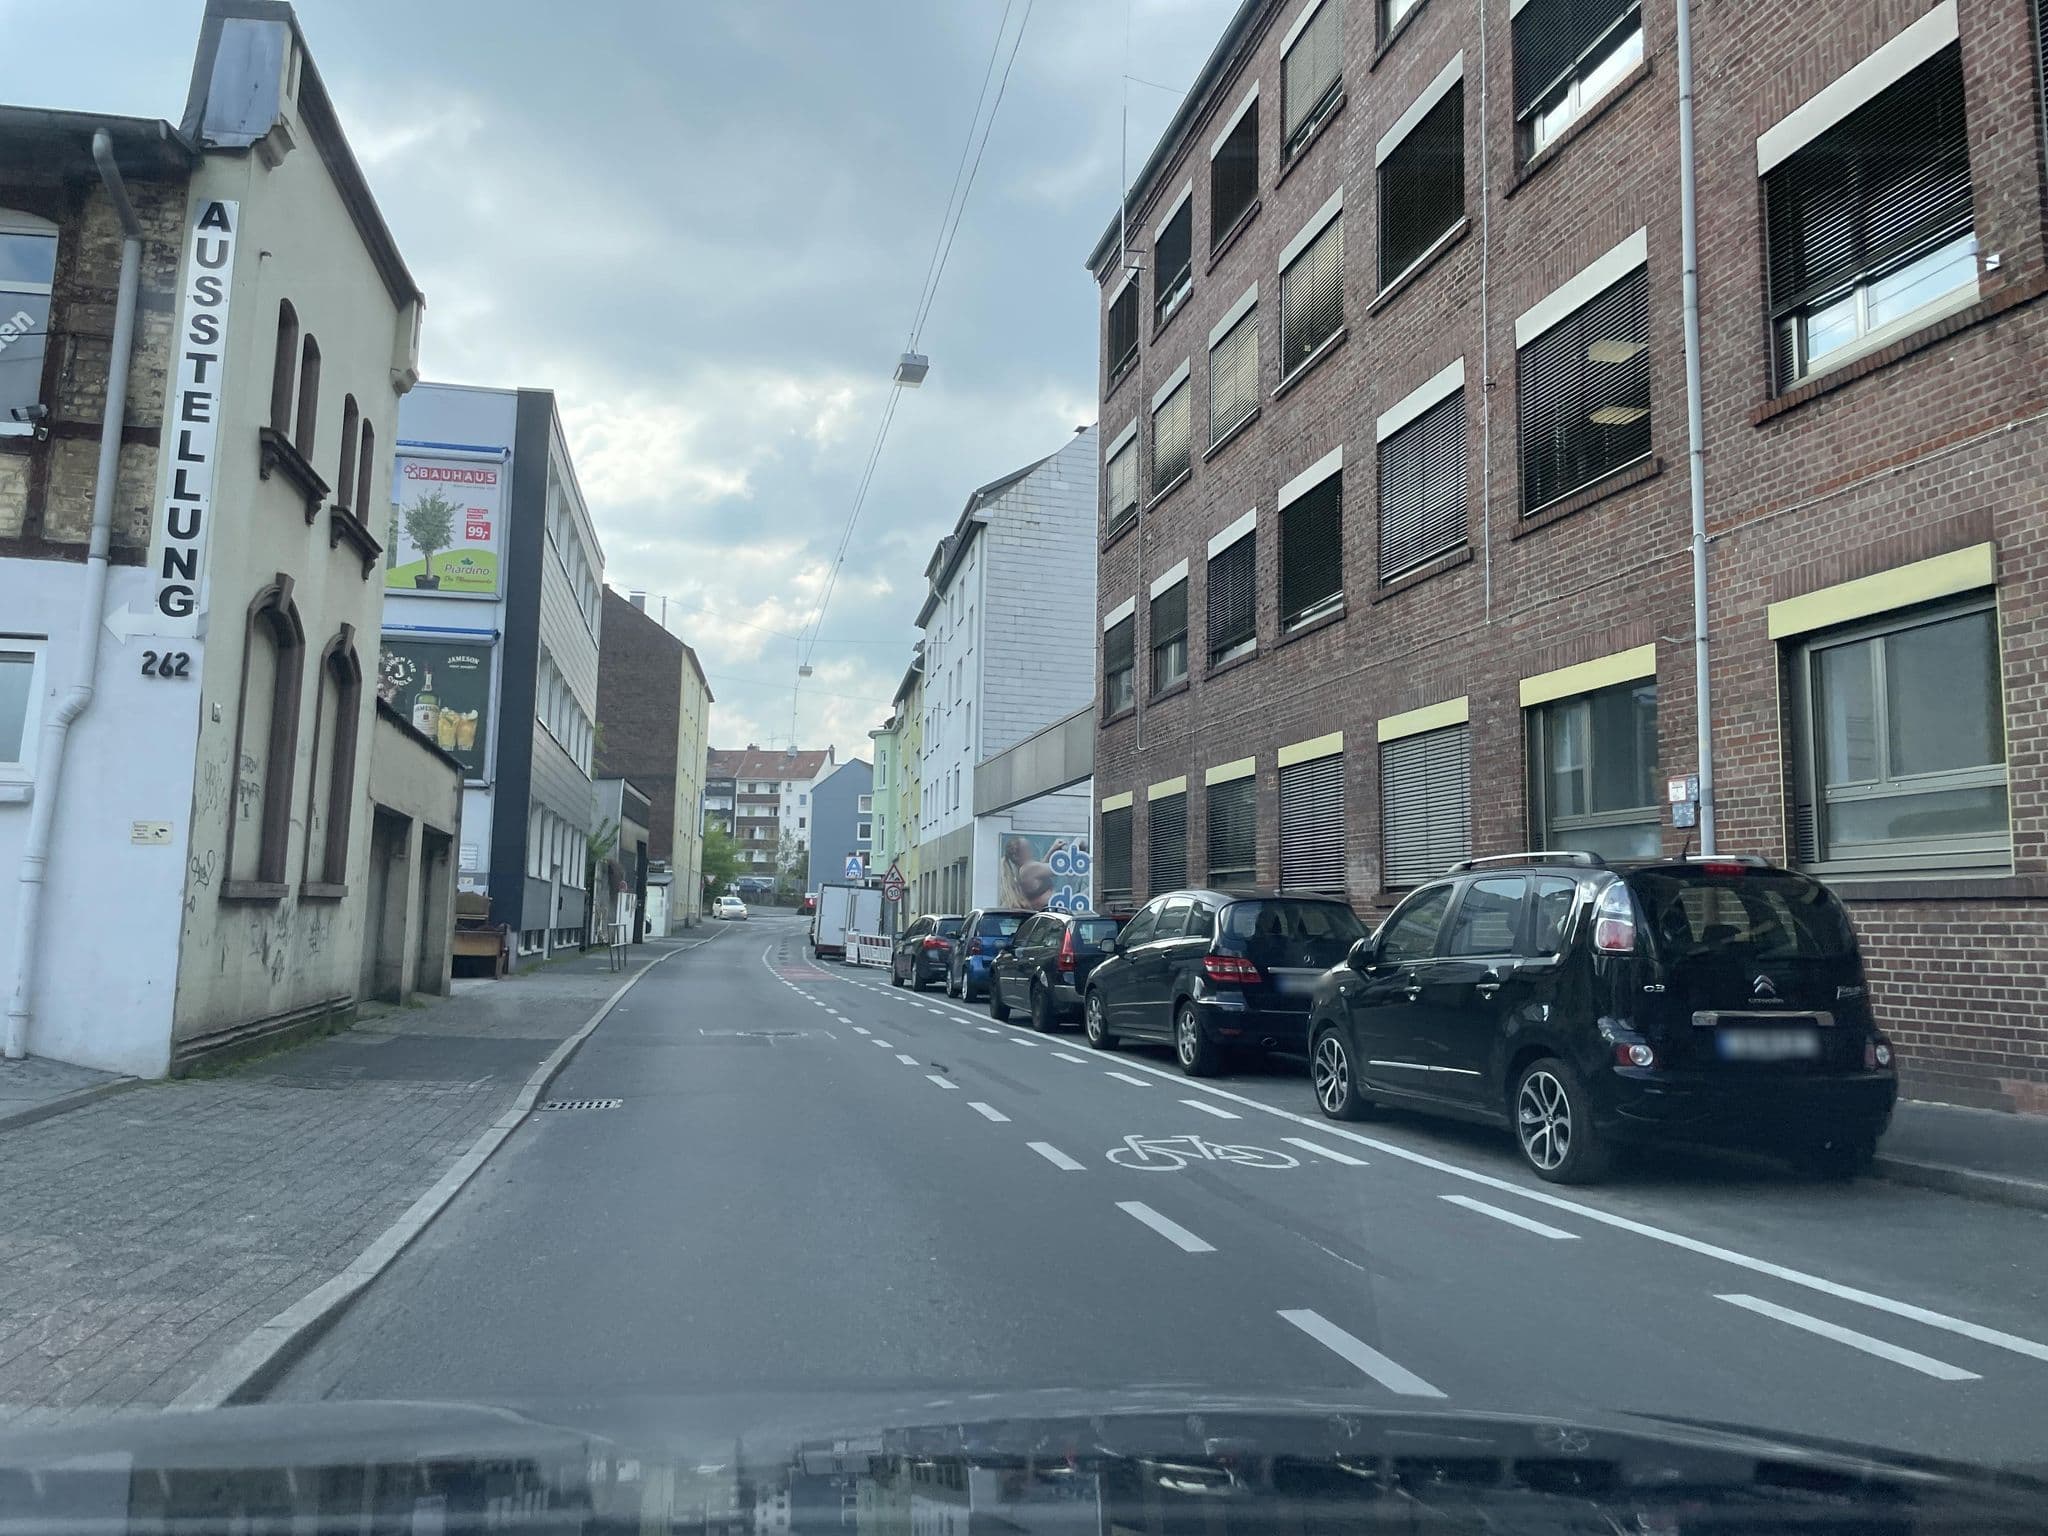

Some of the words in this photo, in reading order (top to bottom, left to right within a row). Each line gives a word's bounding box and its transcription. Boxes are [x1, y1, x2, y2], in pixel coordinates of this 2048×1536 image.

[0, 311, 35, 352] en
[158, 202, 233, 618] AUSSTELLUNG
[419, 468, 497, 484] BAUHAUS
[444, 563, 490, 575] Piardino
[141, 650, 190, 677] 262
[447, 655, 480, 665] JAMESON
[889, 889, 899, 898] 30
